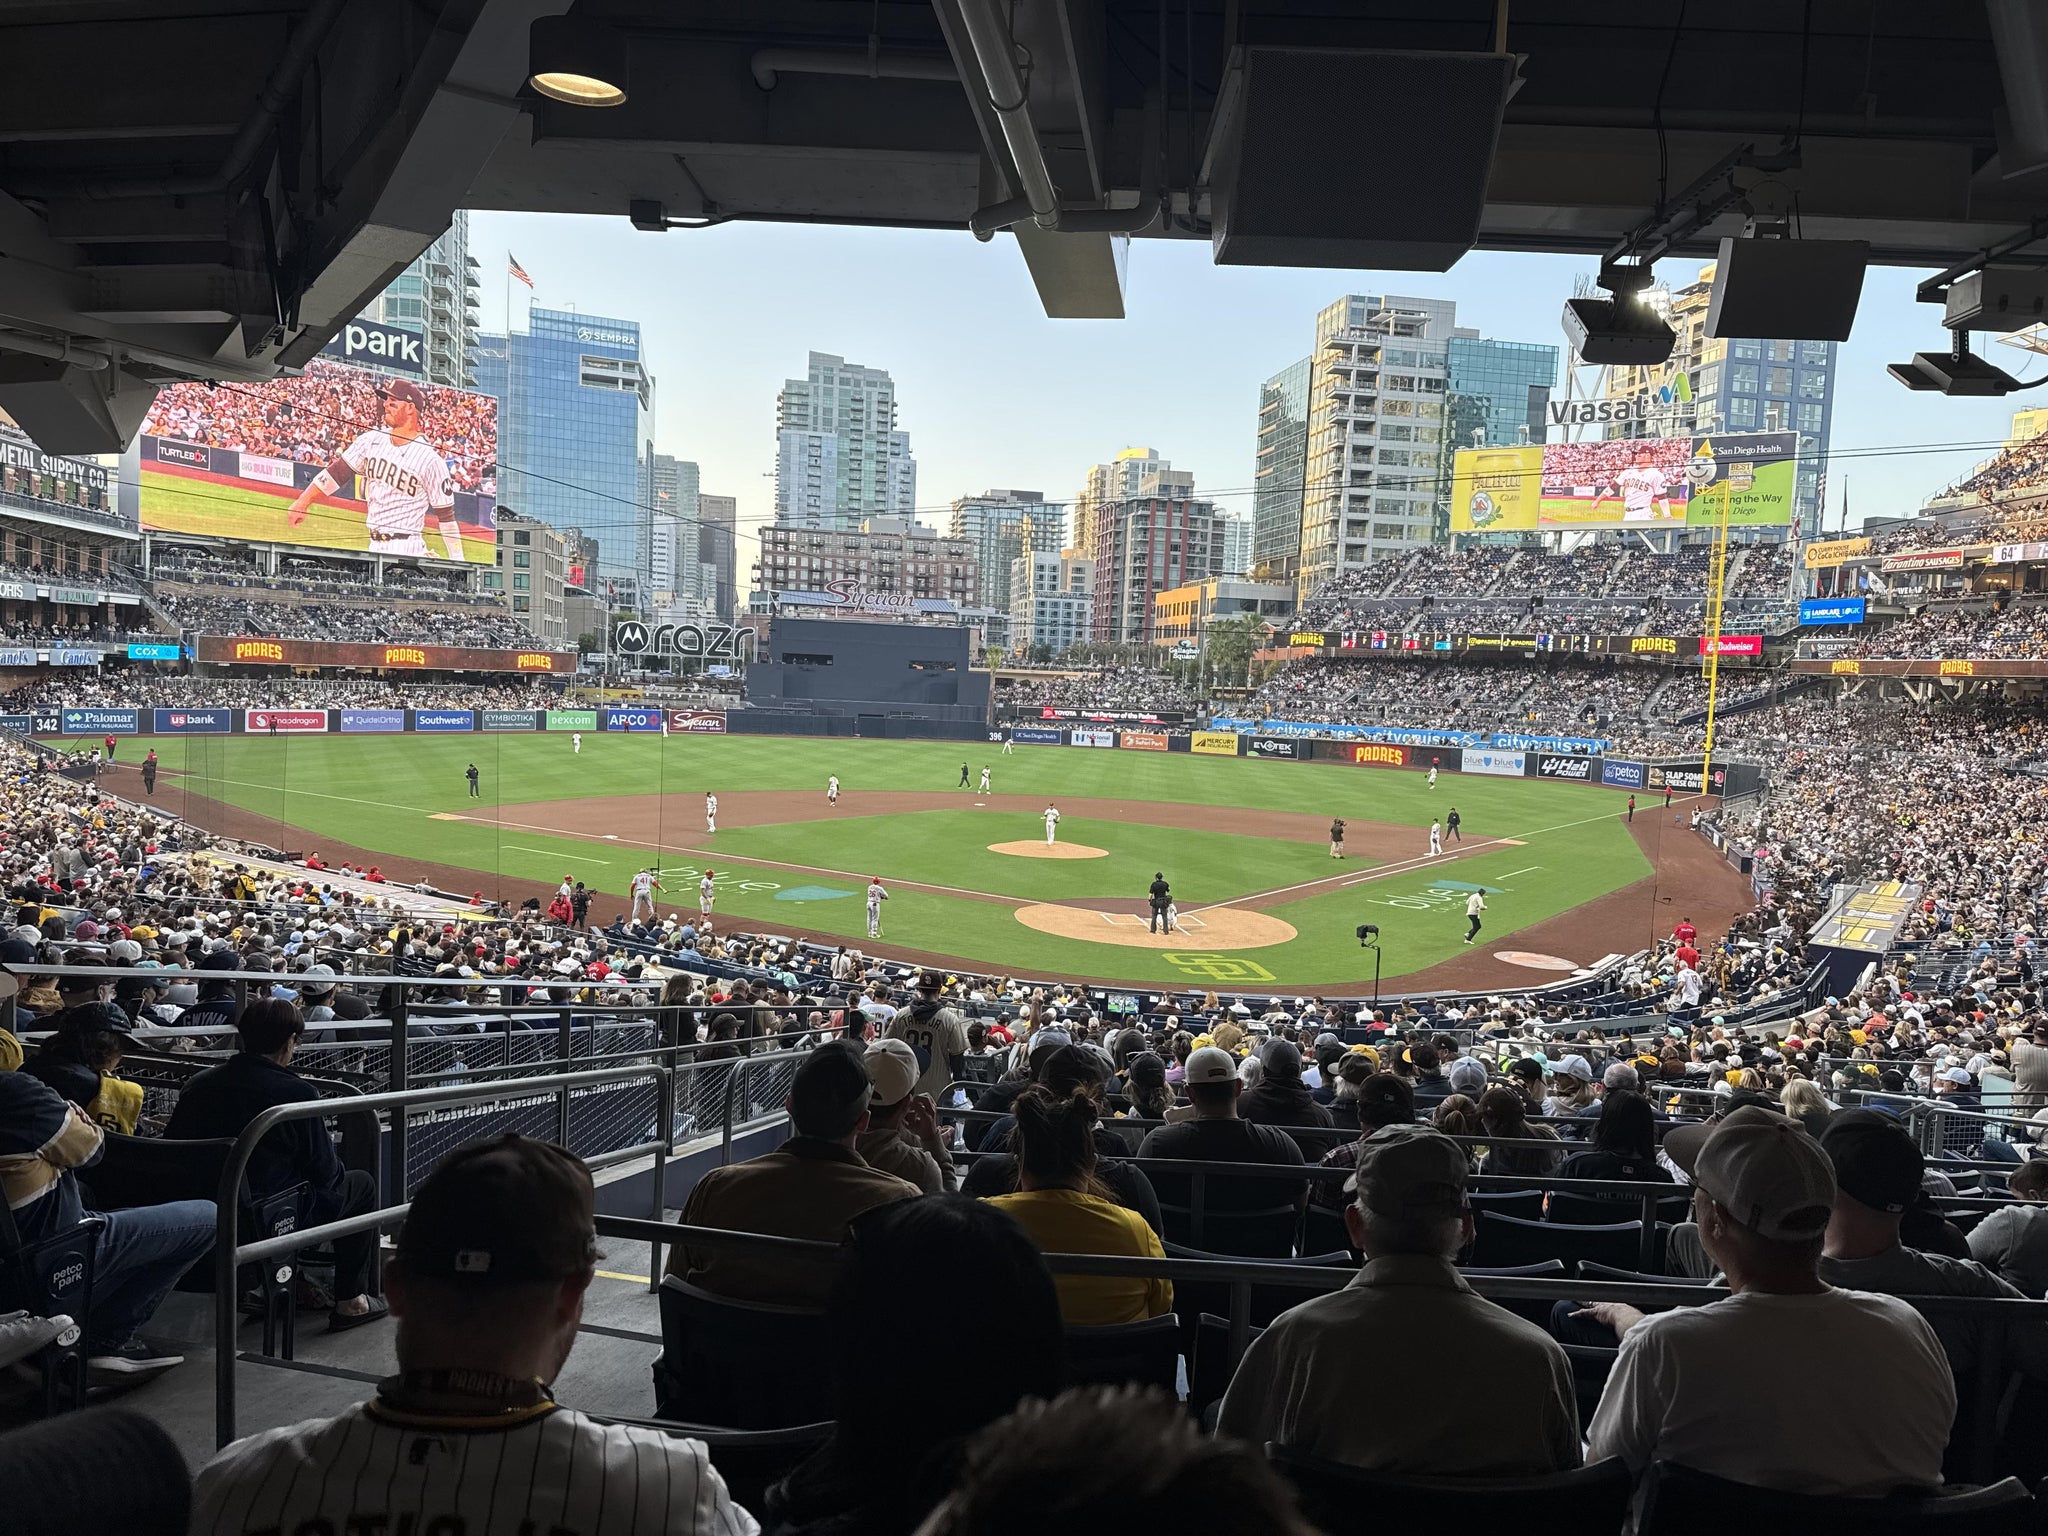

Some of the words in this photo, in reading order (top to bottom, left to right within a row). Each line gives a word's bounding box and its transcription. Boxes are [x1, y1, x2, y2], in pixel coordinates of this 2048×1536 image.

[345, 324, 420, 364] park
[593, 332, 636, 345] SEMPRA
[1551, 395, 1647, 424] Viasat
[160, 446, 207, 463] TURTLEBOX
[1718, 447, 1733, 455] San
[1734, 446, 1756, 456] Diego
[1756, 445, 1782, 454] Health
[40, 454, 85, 484] SUPPLY
[89, 468, 107, 490] CO.
[253, 463, 273, 476] BULLY
[364, 457, 419, 498] PADRES
[1744, 495, 1760, 503] the
[1761, 494, 1783, 504] Way
[1732, 508, 1757, 516] Diego
[1883, 557, 1924, 570] Tarantino
[1925, 555, 1961, 567] SAUSAGES
[824, 578, 916, 612] Sycuan
[652, 623, 756, 658] razr
[1290, 632, 1325, 646] PADRES
[1630, 637, 1677, 654] PADRES
[236, 642, 283, 660] PADRES
[386, 648, 425, 665] PADRES
[1169, 647, 1200, 655] Gallagher
[517, 654, 552, 669] PADRES
[1832, 661, 1859, 674] PADRES
[1939, 661, 1973, 676] PADRES
[85, 712, 134, 723] Palomar
[171, 716, 185, 724] us
[187, 714, 215, 724] bank
[356, 716, 400, 725] QuidelOrtho
[419, 715, 464, 725] Southwest
[484, 714, 534, 722] CYMBIOTIKA
[609, 714, 647, 726] ARCO
[673, 713, 720, 730] Sycuan
[1120, 711, 1127, 719] of
[1128, 711, 1137, 719] the
[1138, 712, 1158, 720] Padres
[36, 718, 58, 731] 342
[989, 732, 1002, 741] 396
[1253, 740, 1292, 751] EVOTEK
[1356, 746, 1403, 765] PADRES
[1464, 756, 1483, 764] blue
[1494, 758, 1514, 766] blue
[1615, 766, 1640, 779] petco
[1665, 771, 1684, 780] SLAP
[1684, 772, 1704, 781] SOME
[1687, 780, 1697, 788] ON
[183, 1012, 228, 1026] GWYNN
[928, 1018, 941, 1031] JR.
[274, 1215, 295, 1232] petco
[277, 1223, 295, 1237] park
[53, 1262, 83, 1284] petco
[58, 1270, 82, 1290] park
[63, 1329, 75, 1342] 10
